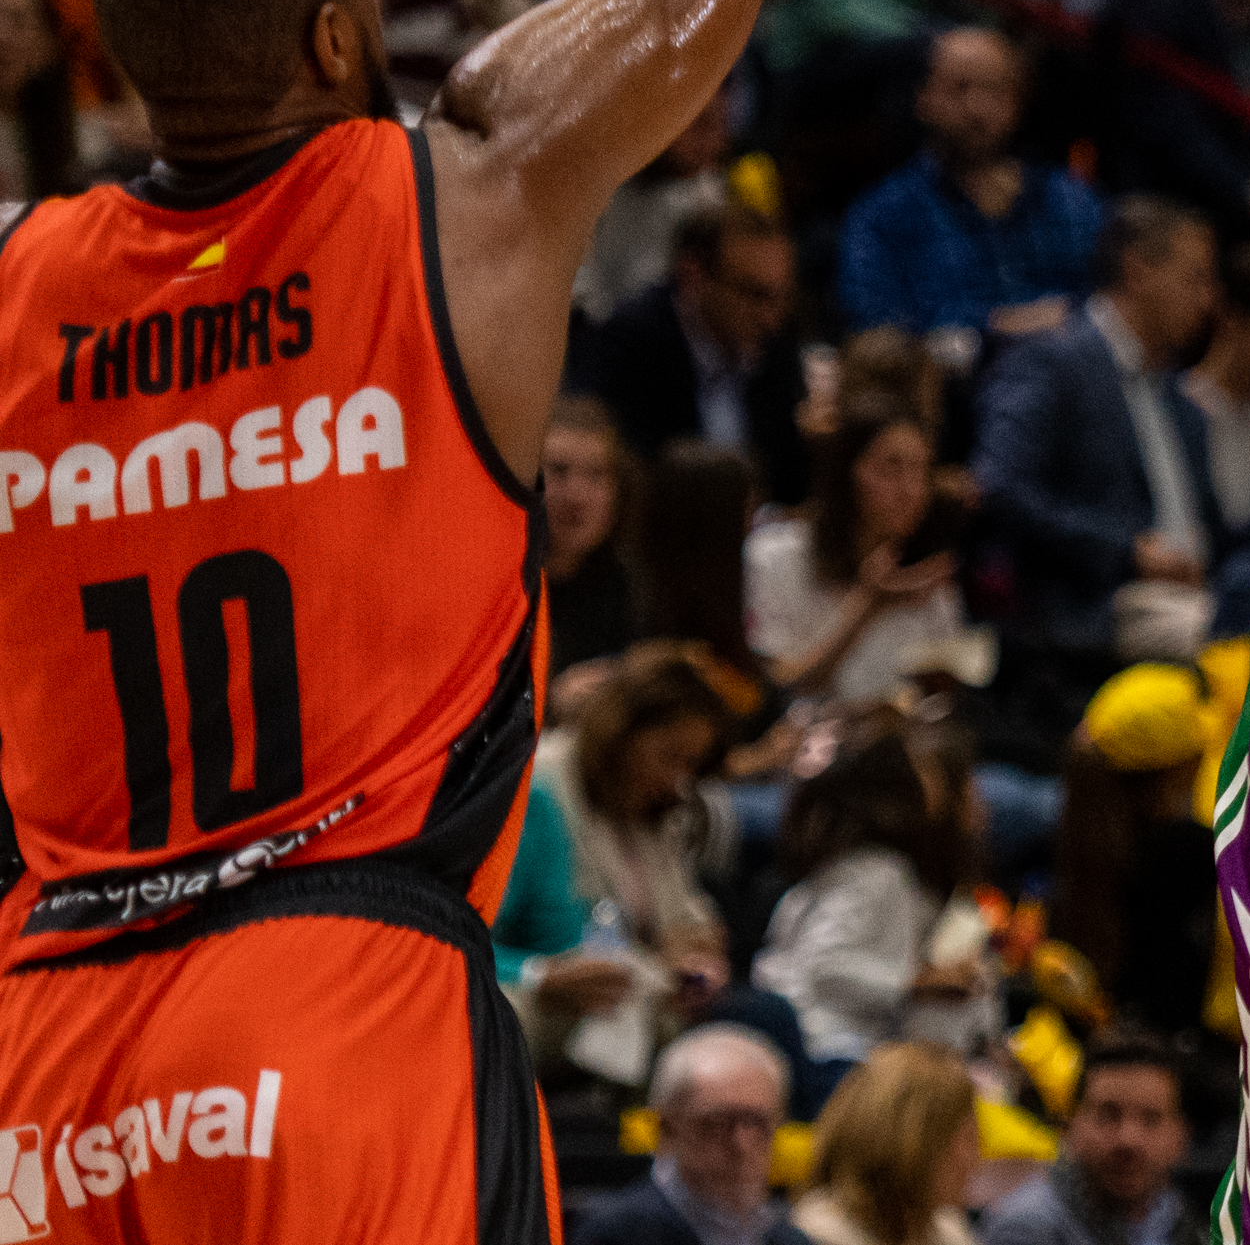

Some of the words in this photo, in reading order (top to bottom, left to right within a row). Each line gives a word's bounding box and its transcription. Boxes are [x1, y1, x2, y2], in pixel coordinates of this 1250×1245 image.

[57, 270, 313, 404] THOMAS
[0, 385, 407, 534] PAMESA
[79, 549, 304, 853] 10
[54, 1068, 282, 1209] isaval
